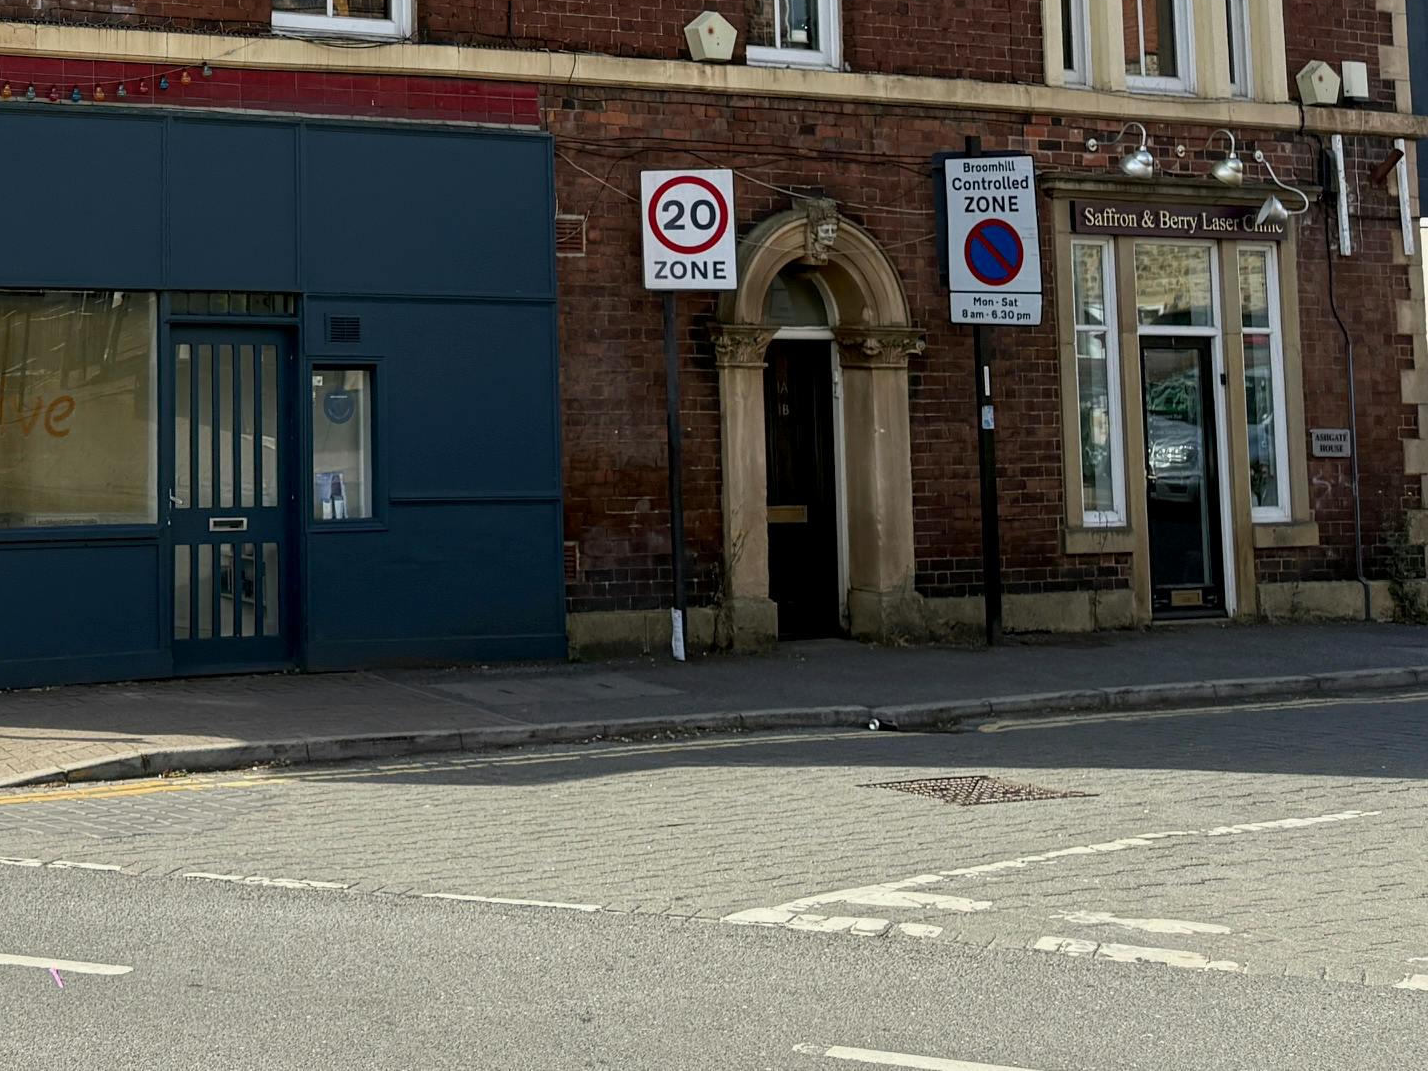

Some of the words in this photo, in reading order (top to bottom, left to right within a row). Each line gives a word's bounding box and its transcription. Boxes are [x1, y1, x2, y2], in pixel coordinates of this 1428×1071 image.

[963, 160, 1016, 173] Broomhill
[952, 175, 1029, 191] Controlled
[964, 195, 1020, 213] ZONE
[661, 199, 717, 231] 20
[1084, 207, 1138, 228] Saffron
[1141, 209, 1155, 228] &
[1159, 210, 1198, 233] Berry
[1202, 212, 1239, 232] Laser
[653, 260, 727, 280] ZONE
[973, 296, 994, 307] Mon
[1001, 297, 1019, 308] Sat
[962, 308, 969, 319] 8
[970, 311, 984, 320] am
[991, 309, 1015, 320] 6.30
[1016, 312, 1031, 323] pm
[1315, 433, 1347, 442] ASHGATE
[1320, 444, 1343, 453] HOUSE
